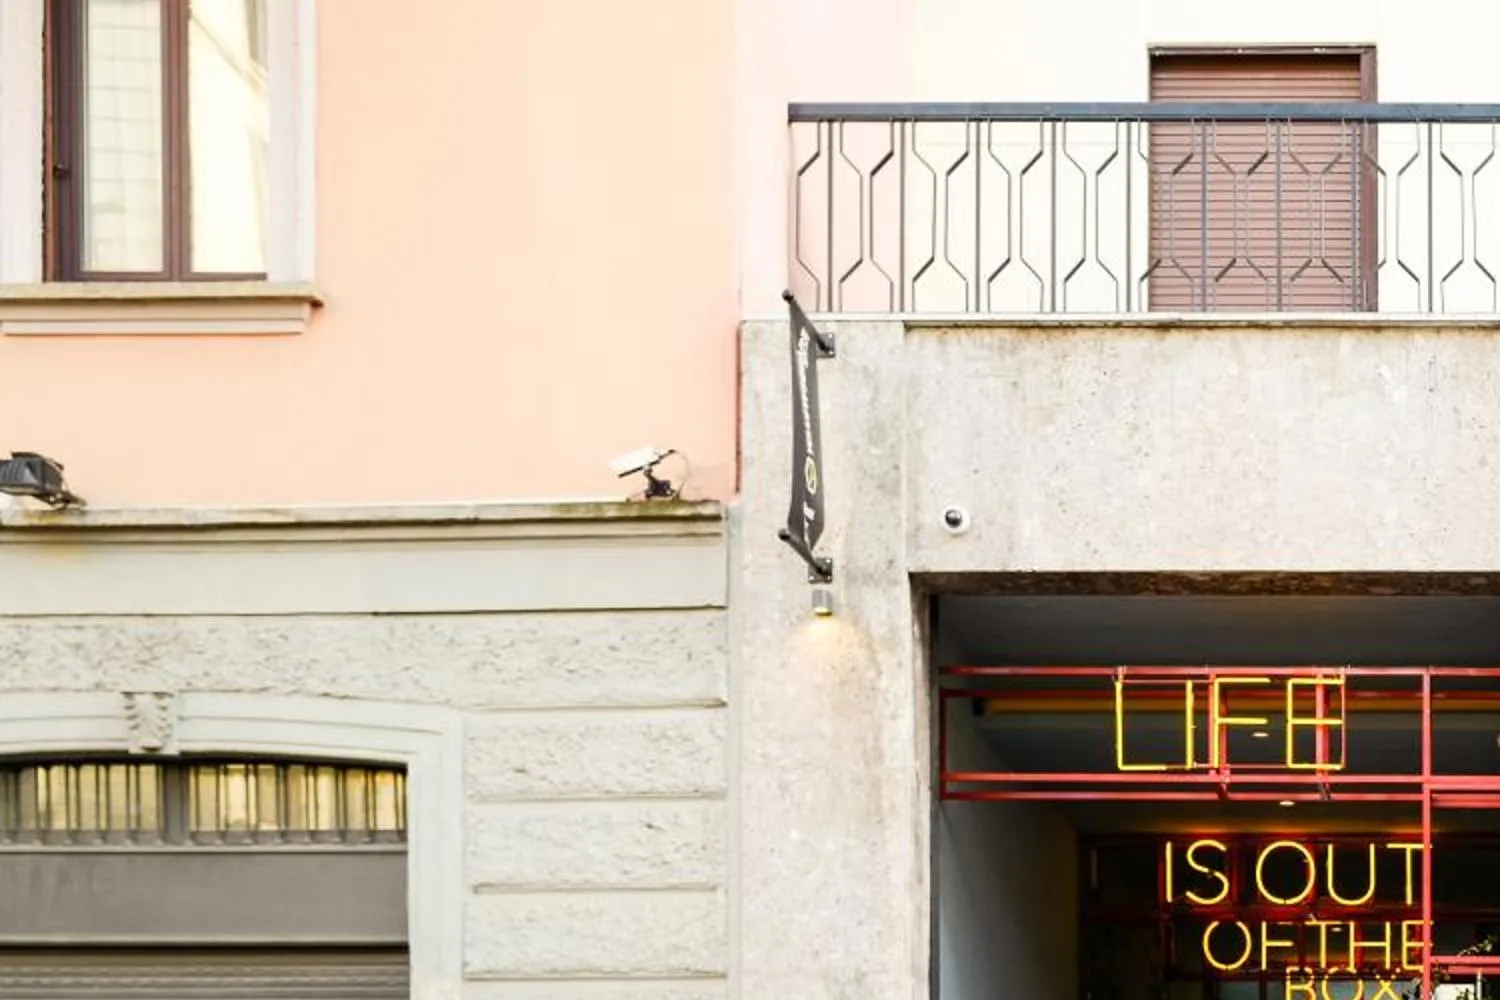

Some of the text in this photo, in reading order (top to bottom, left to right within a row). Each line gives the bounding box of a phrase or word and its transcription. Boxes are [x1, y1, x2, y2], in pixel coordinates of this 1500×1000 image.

[1114, 676, 1345, 771] LIFE
[1164, 839, 1433, 905] IS OUT
[1203, 920, 1434, 971] OF THE
